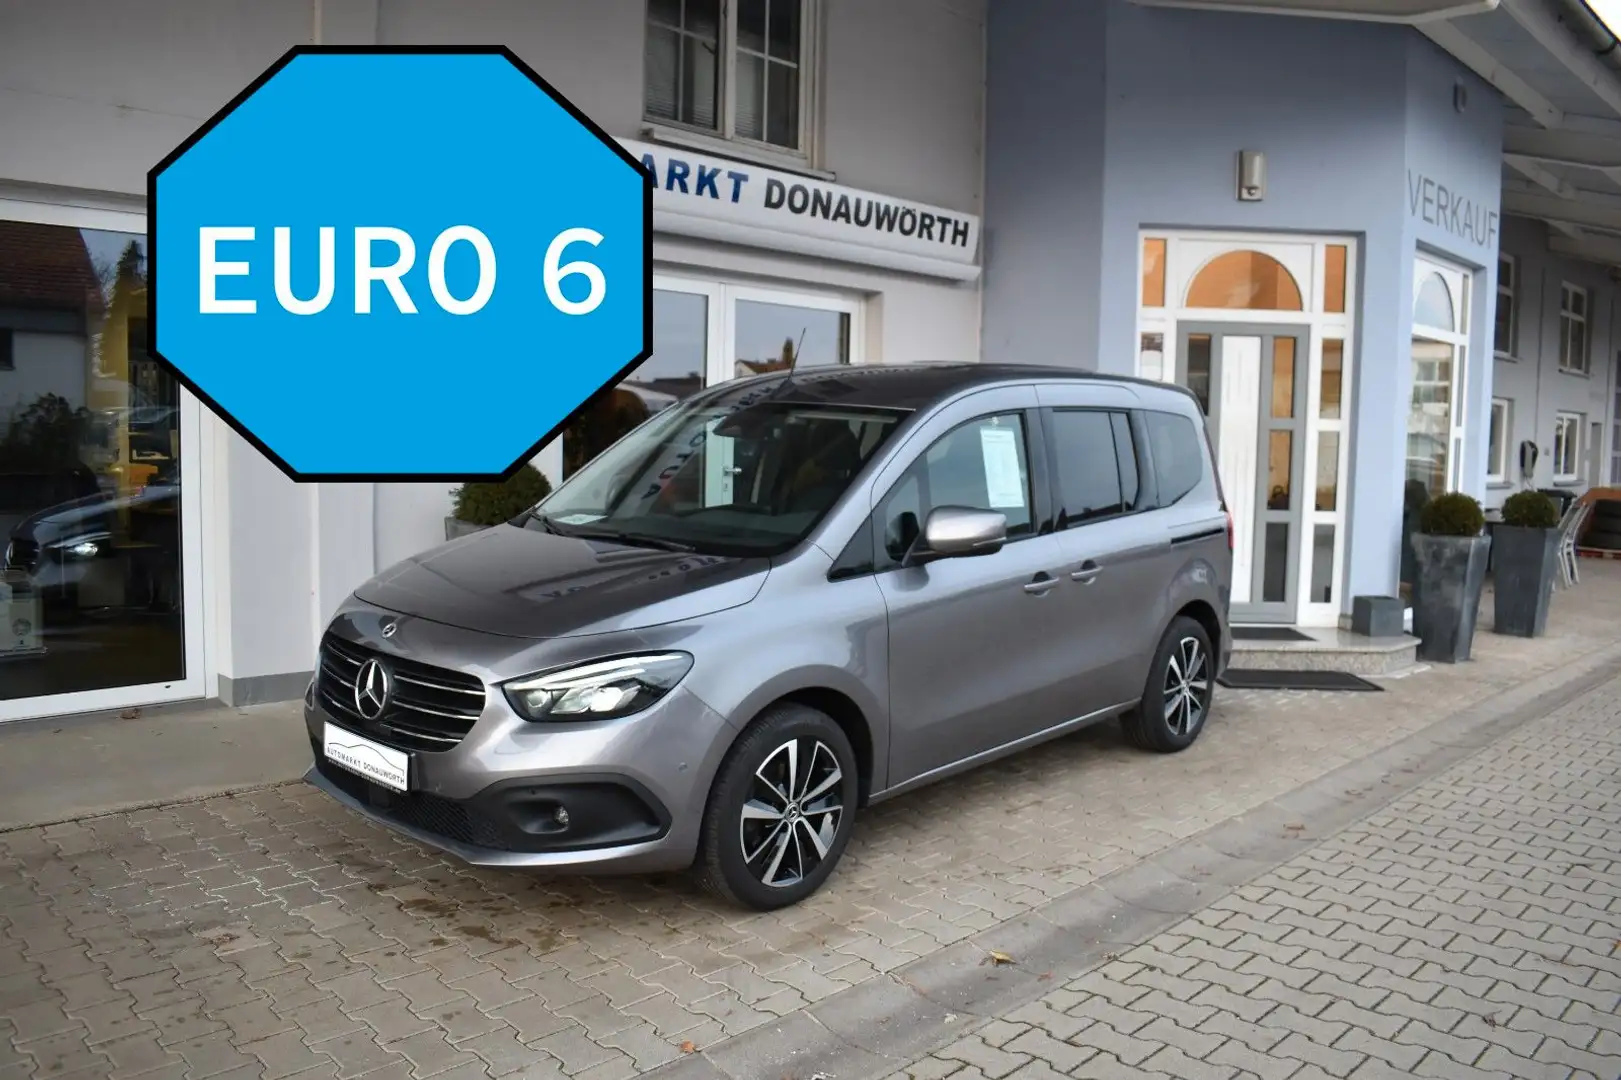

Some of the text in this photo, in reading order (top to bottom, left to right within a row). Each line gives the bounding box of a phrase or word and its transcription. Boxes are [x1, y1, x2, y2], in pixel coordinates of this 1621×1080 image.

[764, 178, 969, 247] DONAUWÖRTH
[1407, 168, 1498, 250] VERKAUF
[327, 746, 361, 768] AUTOMARKT
